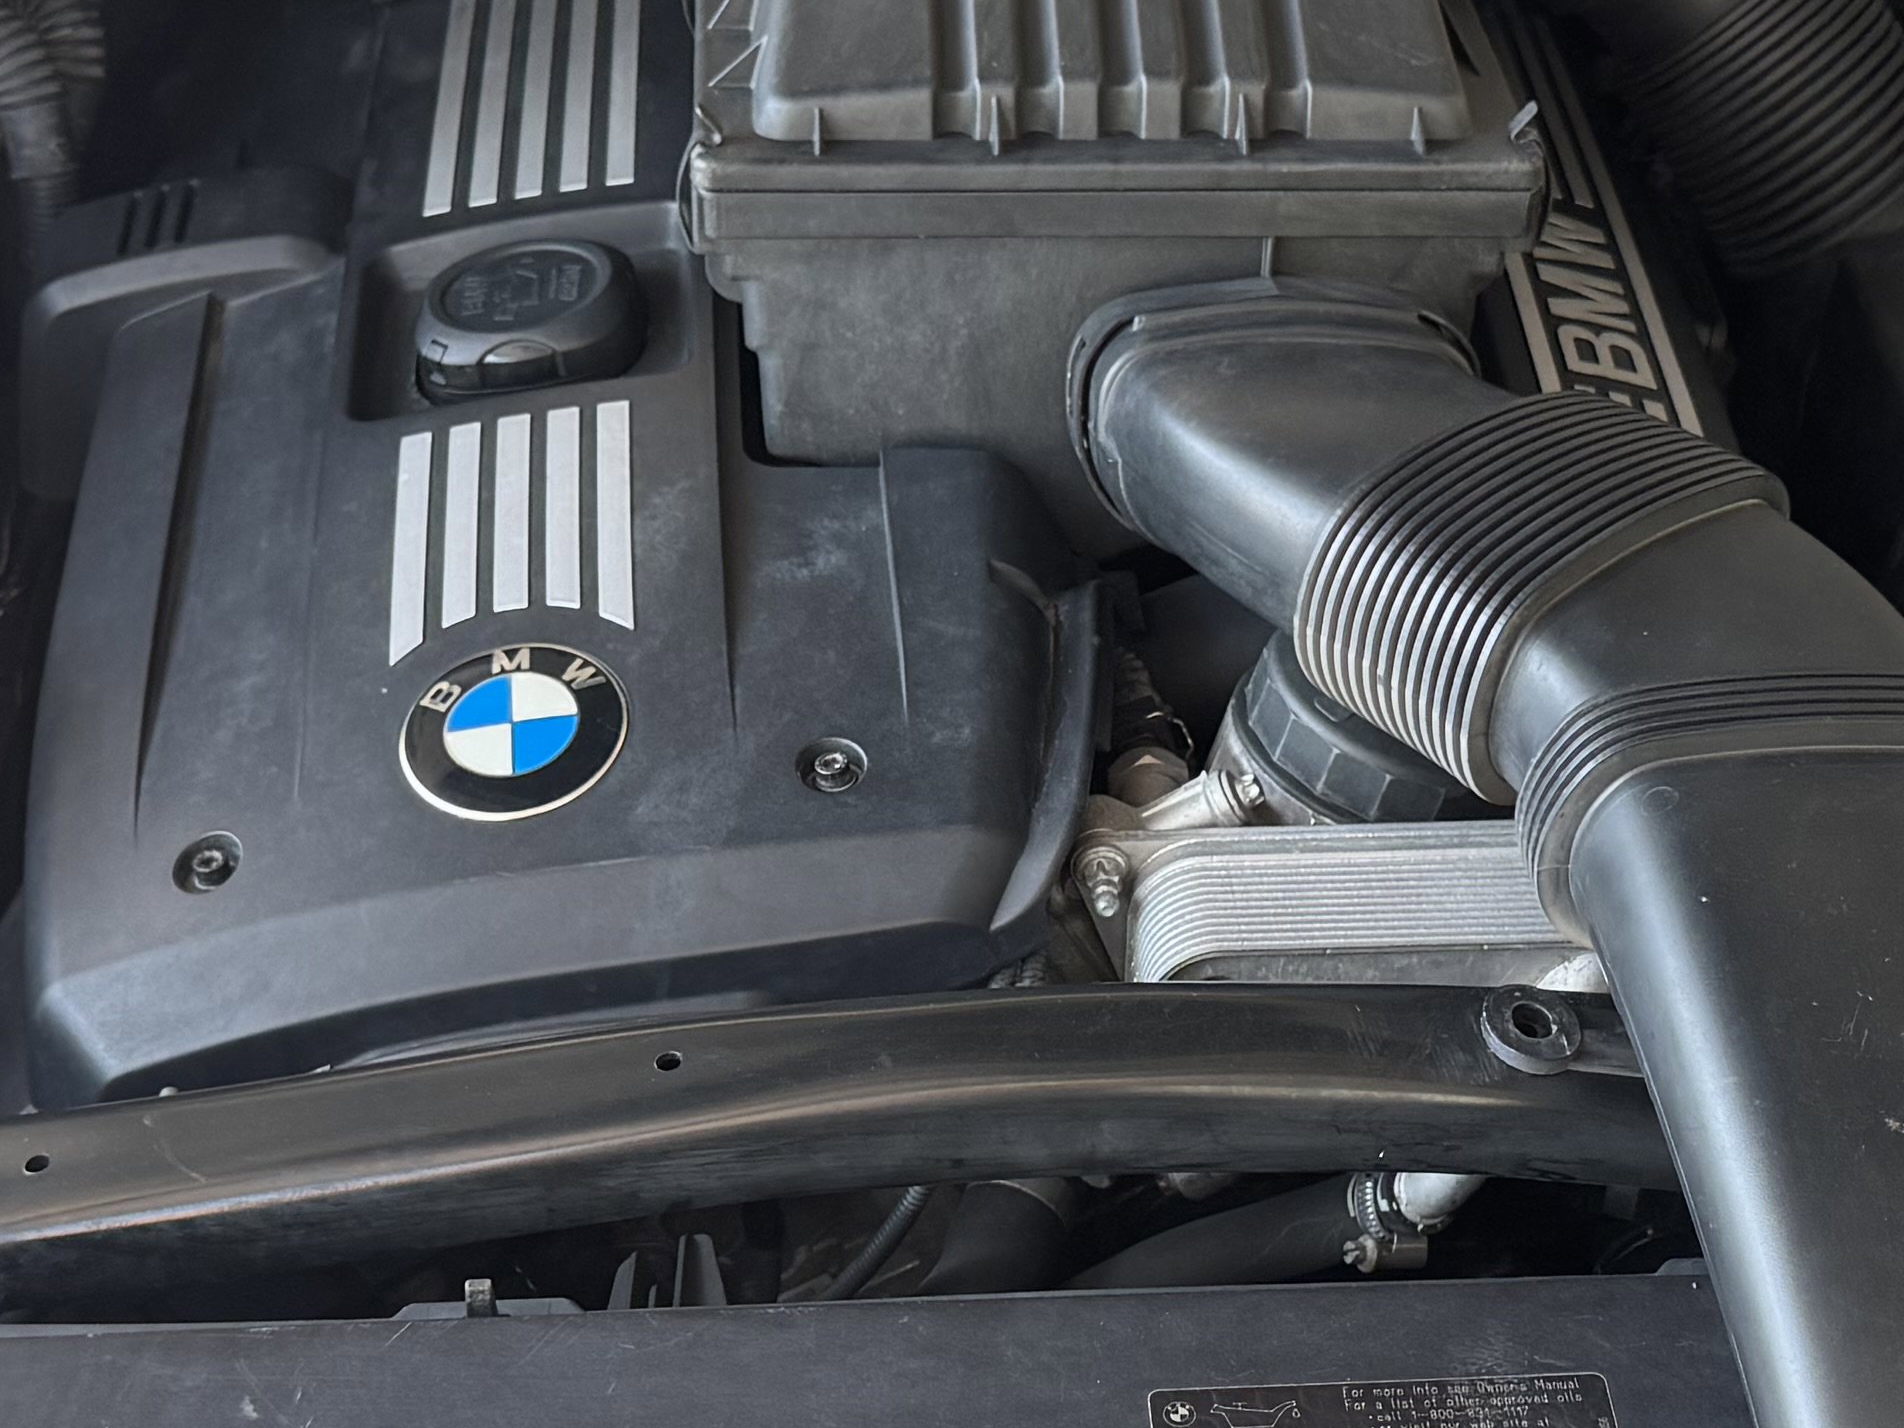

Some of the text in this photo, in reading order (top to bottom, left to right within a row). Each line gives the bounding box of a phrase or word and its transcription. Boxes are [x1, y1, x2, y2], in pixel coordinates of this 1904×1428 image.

[1532, 210, 1657, 390] BMW
[419, 648, 606, 713] BMW
[1535, 1378, 1580, 1391] Manual
